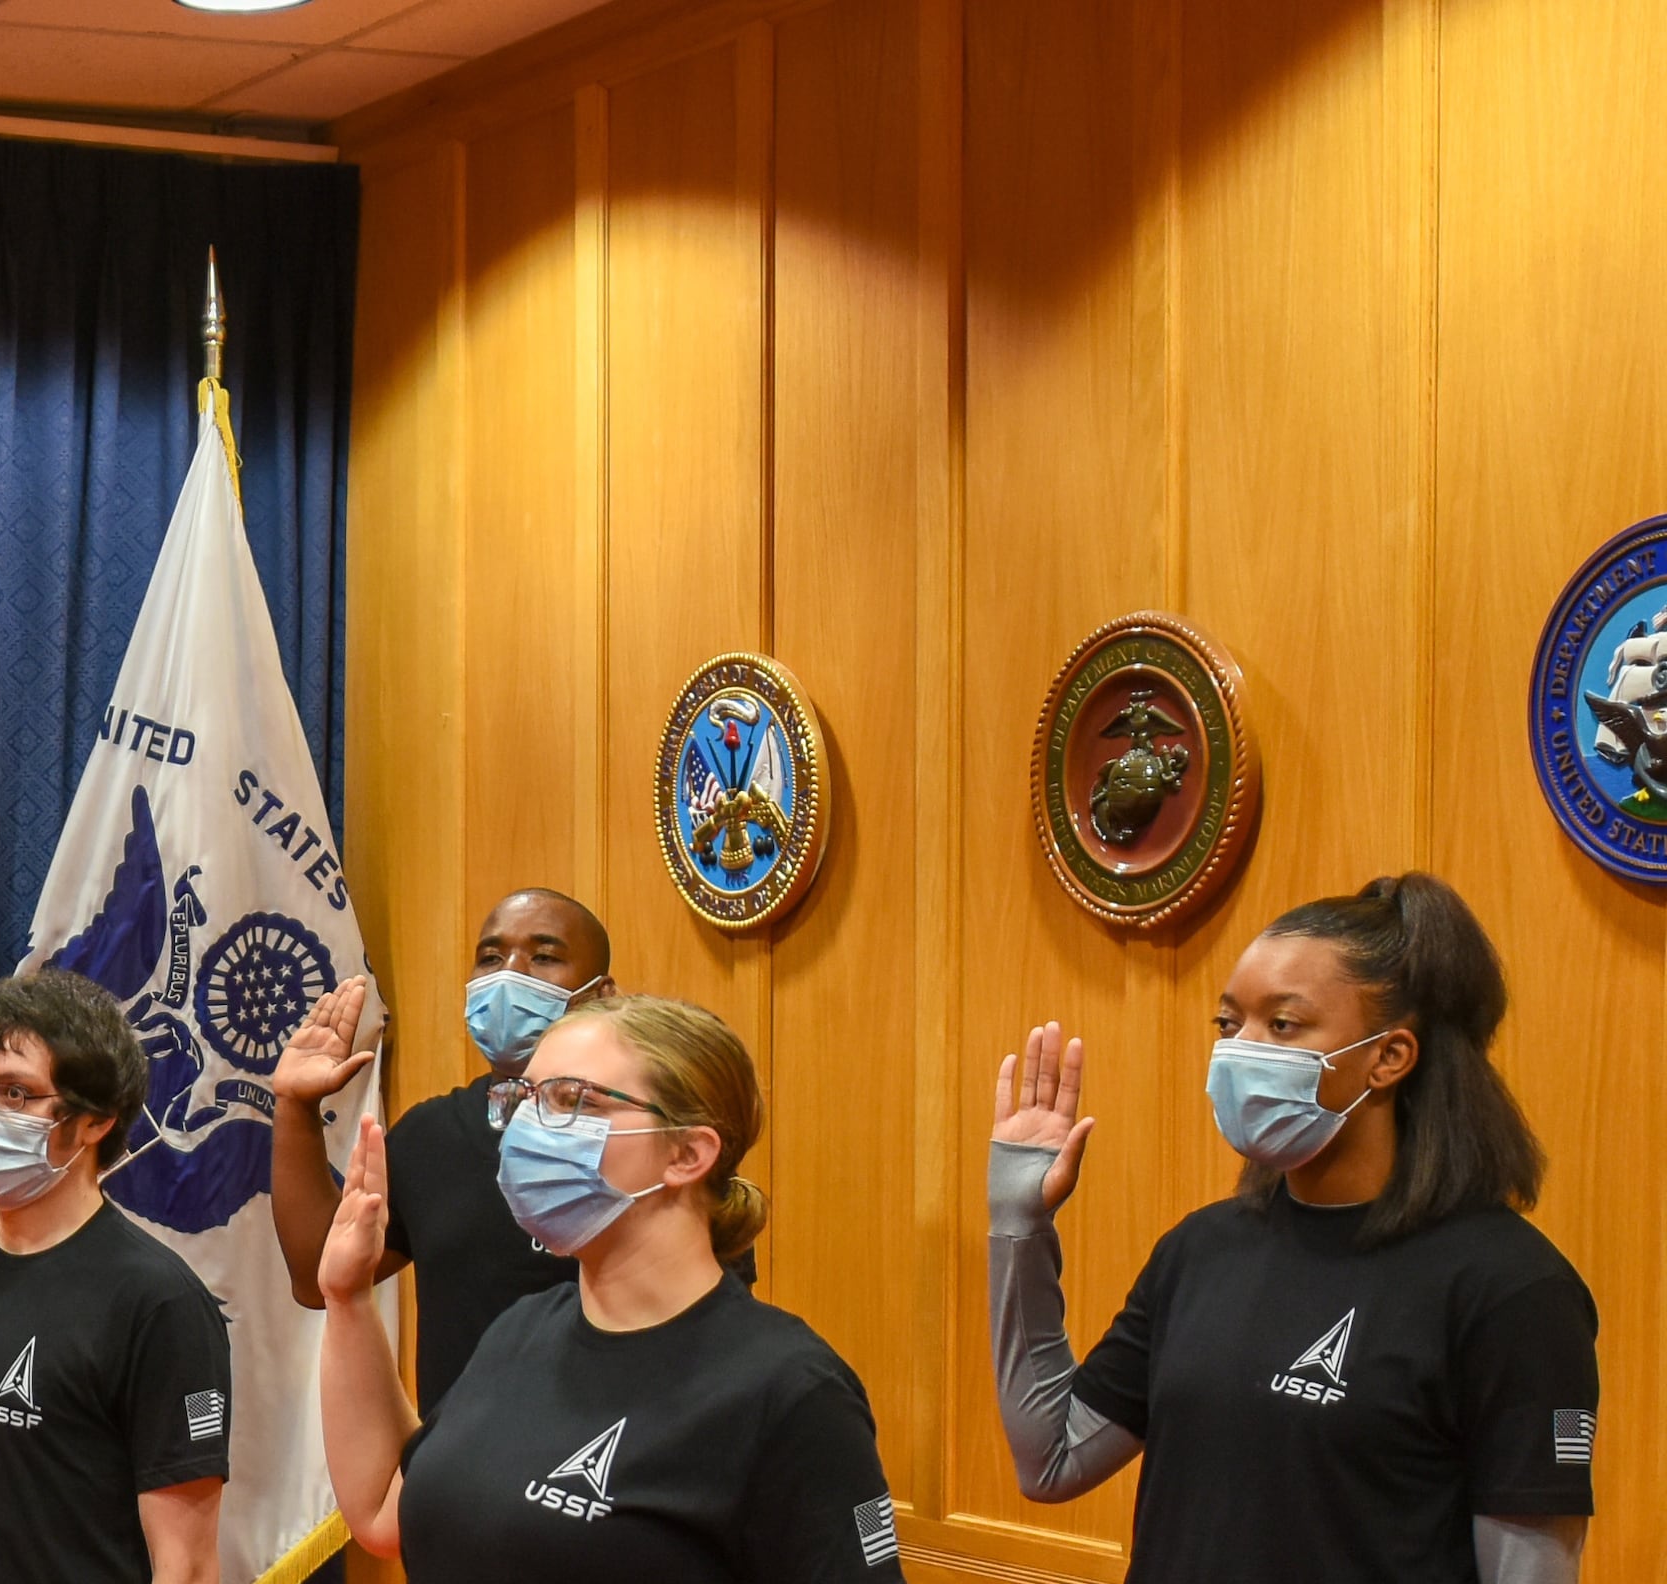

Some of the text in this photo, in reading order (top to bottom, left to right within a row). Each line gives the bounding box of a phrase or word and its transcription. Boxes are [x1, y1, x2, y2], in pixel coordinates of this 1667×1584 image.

[1551, 550, 1656, 696] DEPARTMENT
[1552, 731, 1605, 825] UNITED
[234, 770, 348, 910] STATES
[1270, 1373, 1346, 1405] USSF
[524, 1480, 612, 1522] USSF
